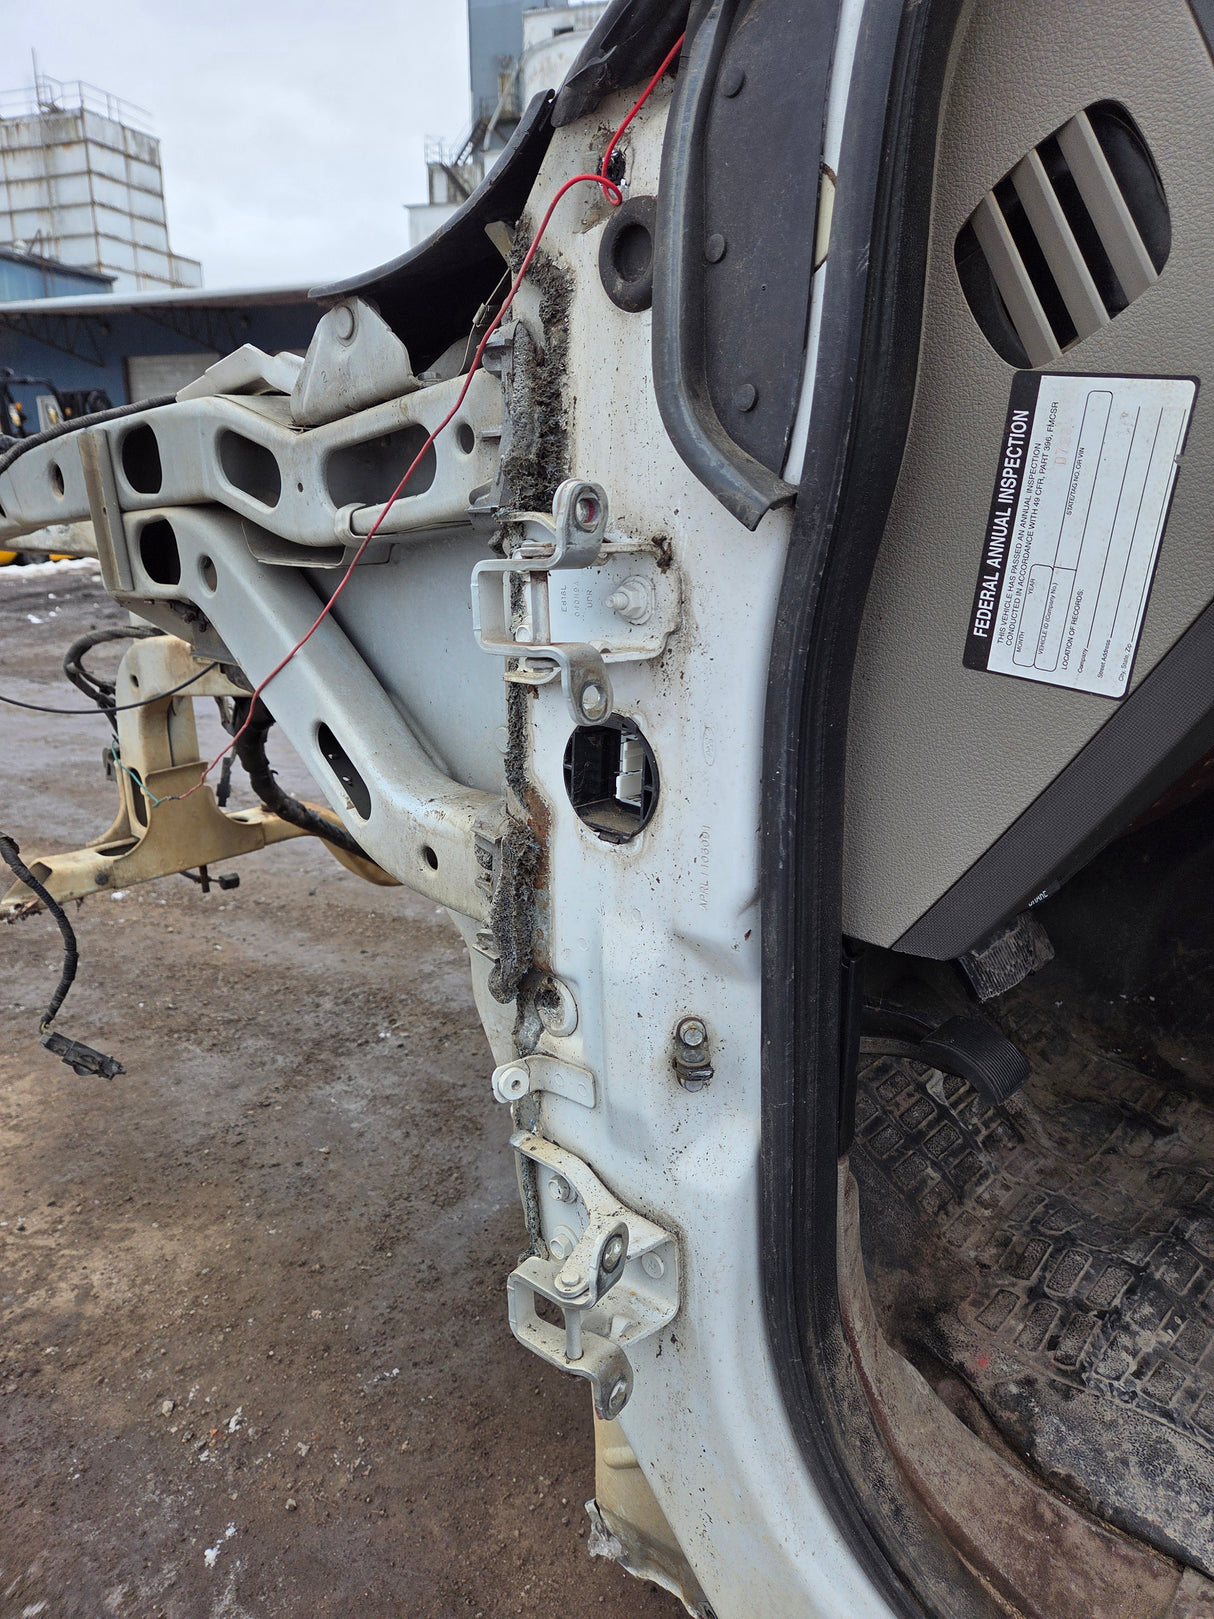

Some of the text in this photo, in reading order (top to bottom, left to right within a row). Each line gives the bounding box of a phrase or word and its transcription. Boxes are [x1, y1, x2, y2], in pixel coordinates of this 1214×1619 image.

[1075, 459, 1083, 470] OR
[1077, 447, 1085, 459] VIN
[1066, 482, 1078, 516] STATE/TAG
[973, 410, 1029, 638] FEDERAL ANNUAL INSPECTION
[1005, 401, 1059, 646] CONDUCTED IN ACCORDANCE WITH 49 CFR, PART 396, FMCSR
[997, 442, 1042, 644] THIS VEHICLE HAS PASSED AN ANNUAL INSPECTION
[1027, 578, 1036, 595] YEAR
[1044, 594, 1056, 623] (Company
[1043, 622, 1049, 630] ID
[1061, 588, 1084, 671] LOCATION OF RECORDS:
[1016, 631, 1025, 653] MONTH
[1038, 630, 1048, 655] VEHICLE
[1077, 648, 1089, 674] Company
[1096, 639, 1111, 679] Street Address
